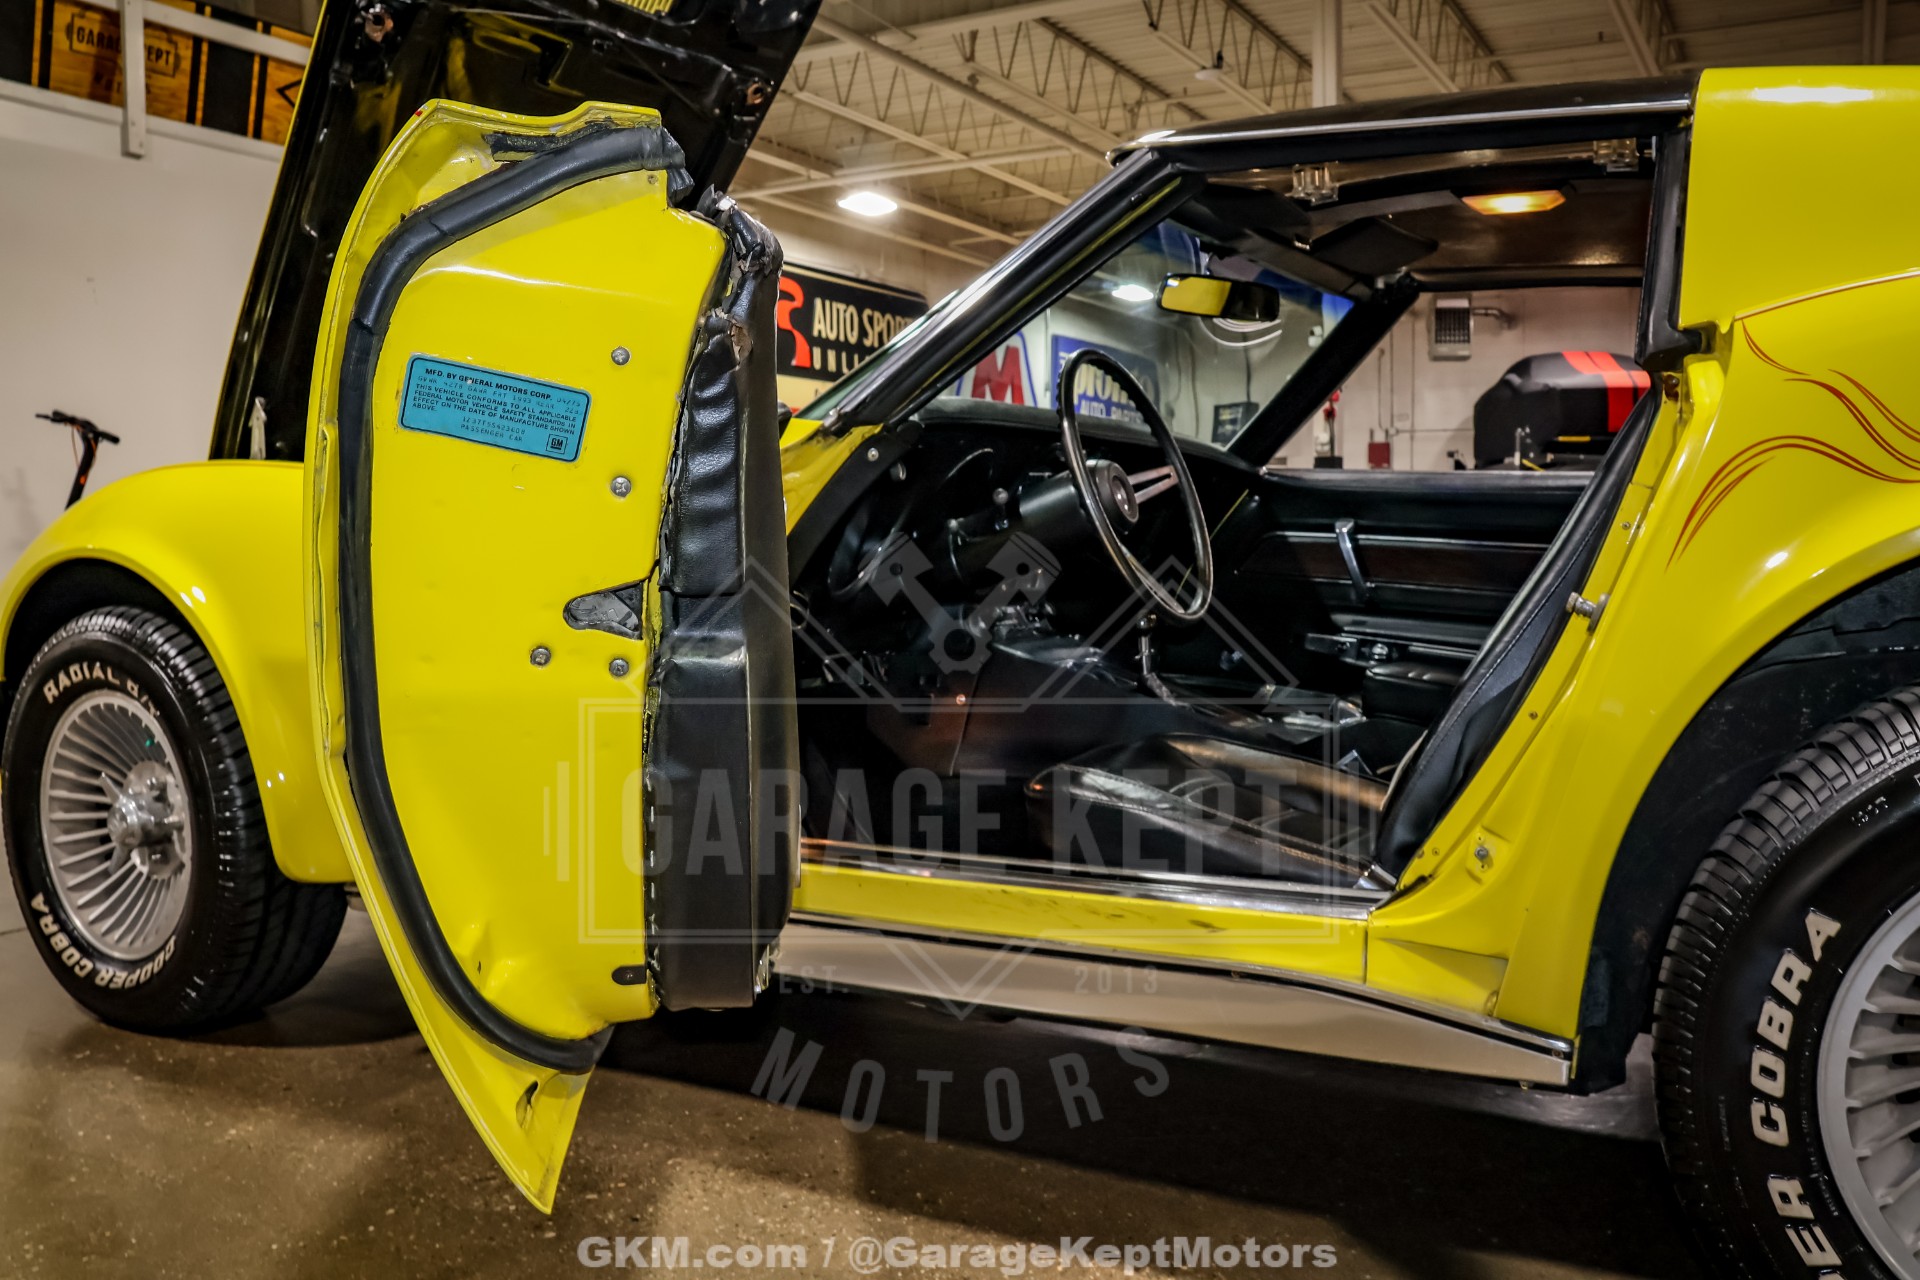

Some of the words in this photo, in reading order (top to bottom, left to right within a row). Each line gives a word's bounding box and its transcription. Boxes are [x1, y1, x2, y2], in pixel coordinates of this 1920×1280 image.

[813, 297, 859, 345] AUTO
[425, 368, 445, 377] MFD.
[458, 375, 494, 388] GENERAL
[495, 382, 528, 395] MOTORS
[530, 390, 552, 400] CORP.
[971, 345, 1024, 405] M
[413, 395, 438, 405] EFFECT
[499, 414, 548, 429] MANUFACTURE
[550, 425, 574, 435] SHOWN
[415, 389, 442, 400] FEDERAL
[446, 395, 468, 405] MOTOR
[472, 401, 497, 411] VEHICLE
[502, 408, 525, 417] SAFETY
[528, 414, 565, 426] STANDARDS
[434, 386, 463, 397] VEHICLE
[467, 393, 507, 407] CONFORMS
[539, 409, 576, 422] APPLICABLE
[460, 424, 503, 438] PASSENGER
[509, 434, 522, 442] CAR
[551, 438, 563, 447] GM
[43, 662, 121, 704] RADIAL
[31, 892, 94, 978] COBRA
[95, 935, 176, 989] COOPER
[1750, 907, 1842, 1147] COBRA
